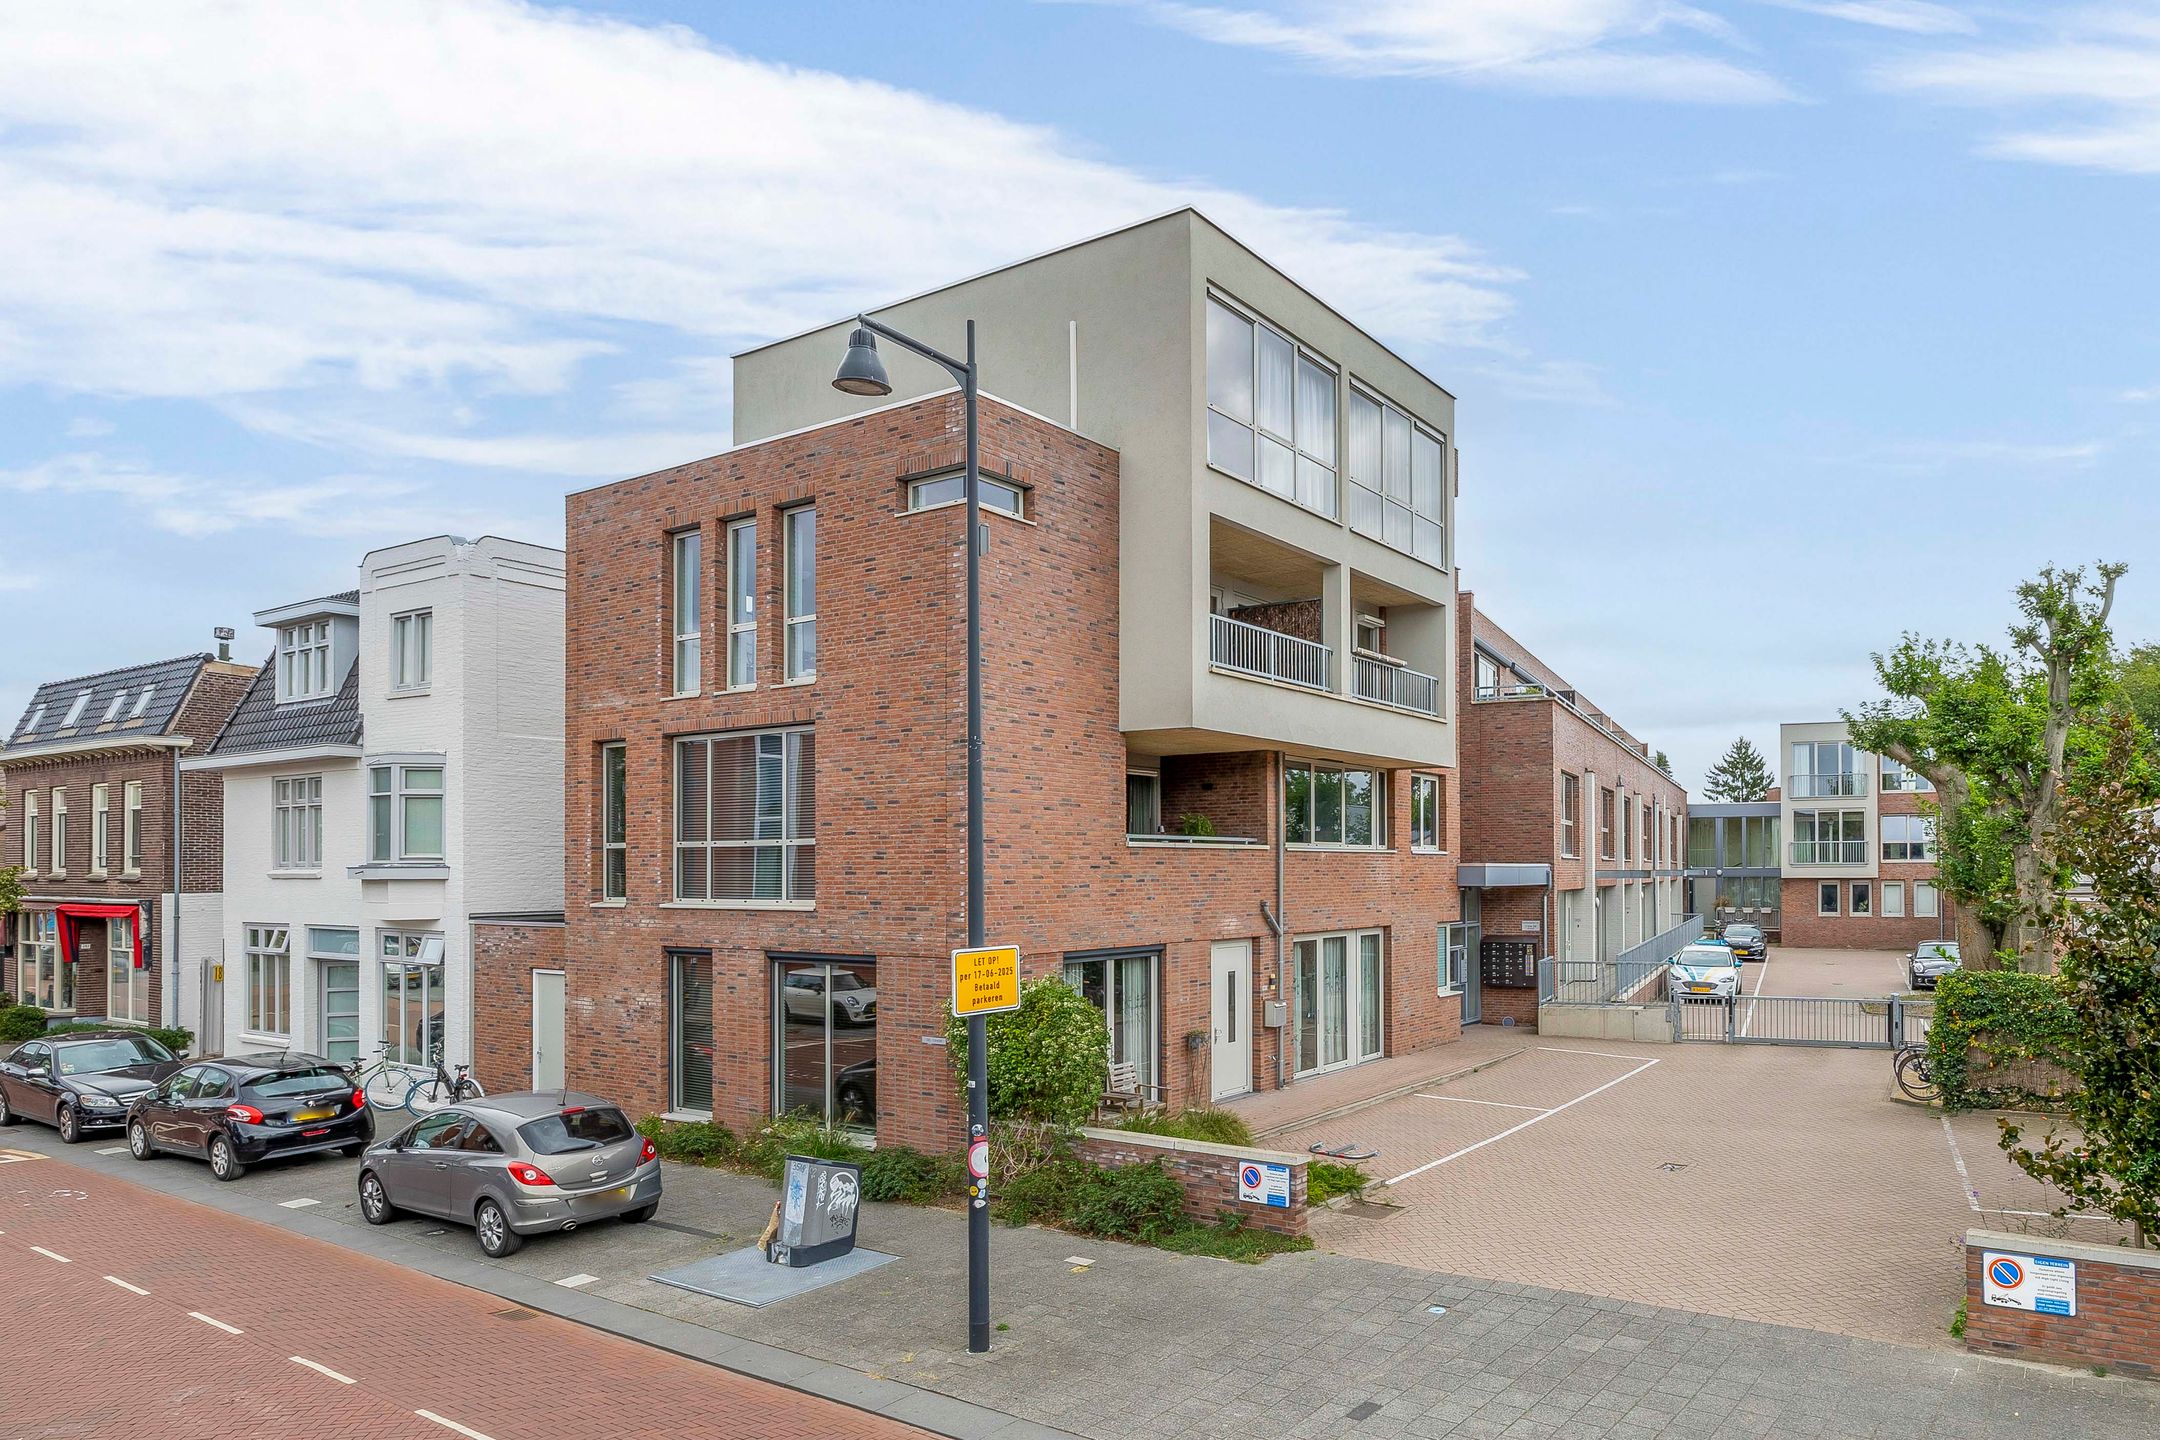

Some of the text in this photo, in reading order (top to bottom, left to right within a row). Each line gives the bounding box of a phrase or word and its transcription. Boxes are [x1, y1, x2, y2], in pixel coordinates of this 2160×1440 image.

[974, 956, 999, 966] LET OP!
[960, 967, 1013, 983] per 17-06-2025
[974, 981, 1000, 992] Betaald
[972, 994, 1002, 1006] parkeren
